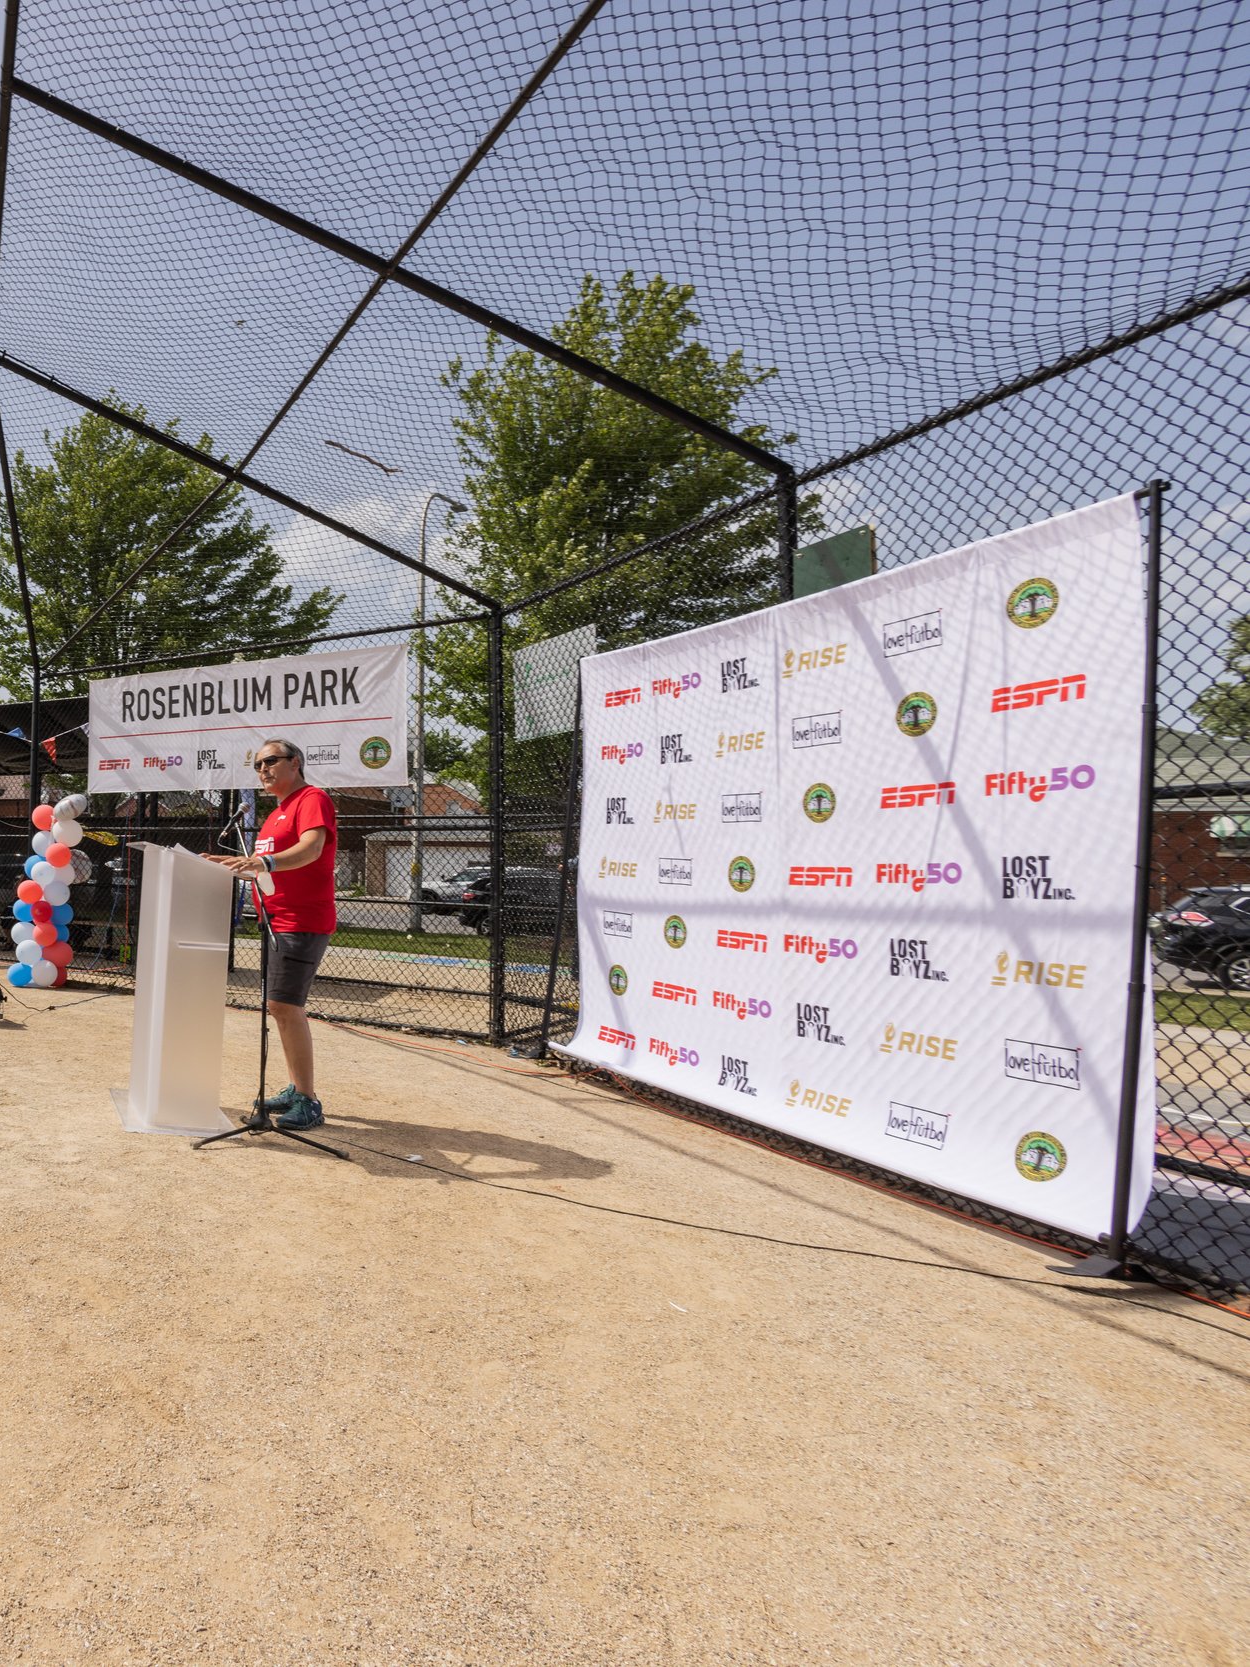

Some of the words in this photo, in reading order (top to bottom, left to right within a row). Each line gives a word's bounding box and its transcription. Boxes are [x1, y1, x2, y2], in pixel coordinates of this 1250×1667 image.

[721, 657, 746, 678] LOST
[798, 644, 848, 672] RISE
[122, 676, 272, 722] ROSENBLUM
[284, 667, 360, 709] PARK
[605, 687, 641, 708] ESPN
[991, 674, 1086, 713] ESPN
[660, 734, 682, 750] LOST
[727, 732, 766, 752] RISE
[99, 759, 130, 770] ESPN
[198, 750, 217, 759] LOST
[607, 798, 626, 811] LOST
[880, 782, 956, 809] ESPN
[664, 804, 697, 820] RISE
[608, 863, 637, 878] RISE
[789, 866, 852, 887] ESPN
[1002, 856, 1050, 878] LOST
[717, 929, 768, 953] ESPN
[890, 938, 927, 960] LOST
[1013, 960, 1087, 989] RISE
[652, 981, 697, 1006] ESPN
[797, 1003, 829, 1024] LOST
[598, 1026, 636, 1050] ESPN
[898, 1031, 958, 1061] RISE
[721, 1055, 748, 1077] LOST
[801, 1088, 852, 1118] RISE
